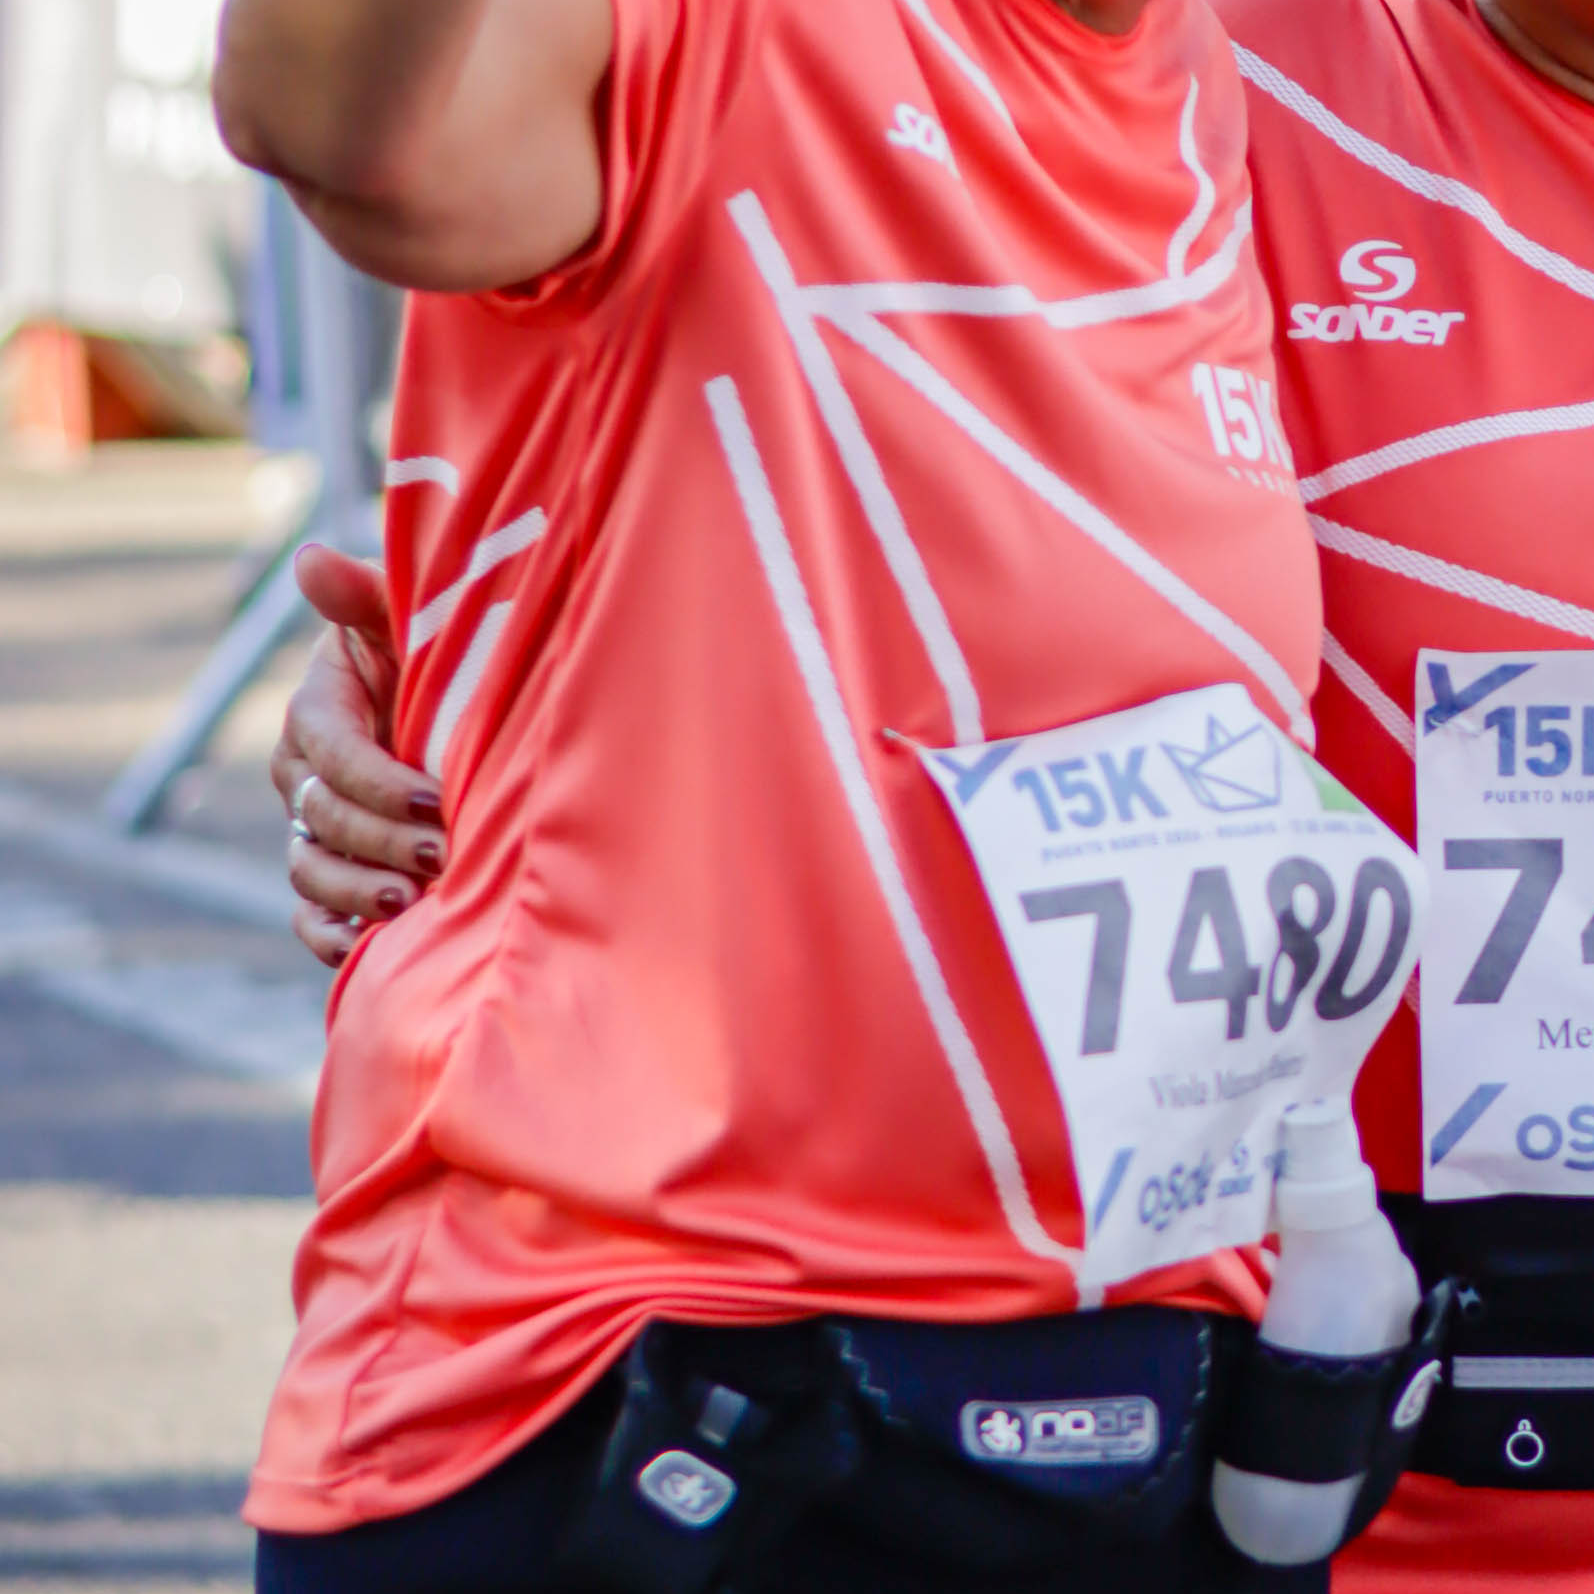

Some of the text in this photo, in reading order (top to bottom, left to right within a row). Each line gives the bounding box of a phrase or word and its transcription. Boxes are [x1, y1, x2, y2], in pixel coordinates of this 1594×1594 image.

[1011, 745, 1171, 834] 15K
[1483, 790, 1554, 804] PUERTO
[1019, 856, 1411, 1056] 7480
